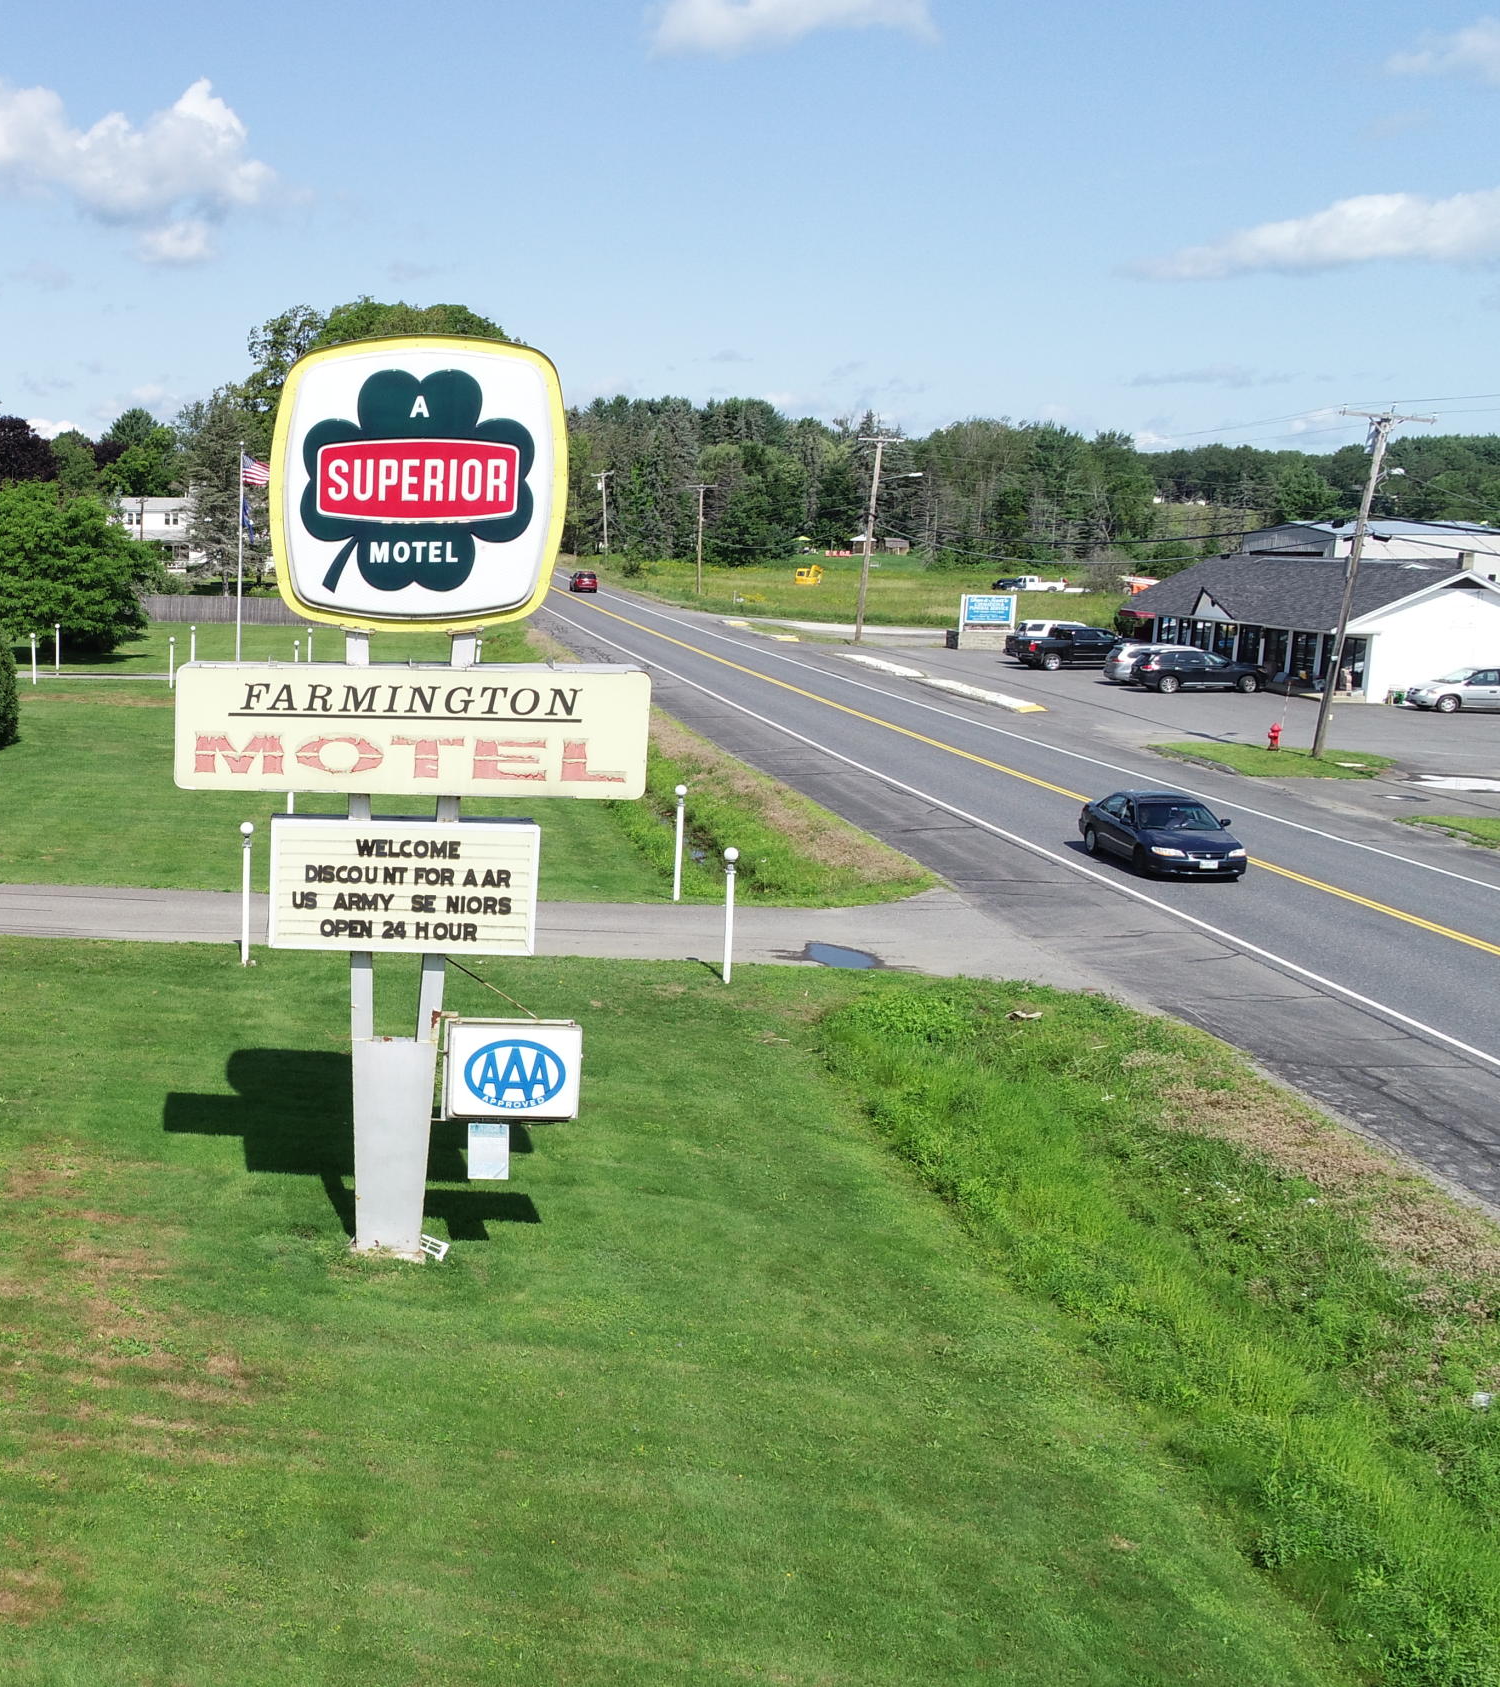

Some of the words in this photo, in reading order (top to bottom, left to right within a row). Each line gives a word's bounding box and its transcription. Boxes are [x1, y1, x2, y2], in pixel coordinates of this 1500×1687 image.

[409, 395, 430, 418] A
[327, 458, 508, 502] SUPERIOR
[369, 541, 459, 564] MOTEL
[239, 683, 584, 717] FARMINGTON
[193, 730, 628, 784] MOTEL
[356, 838, 461, 860] WELCOME
[305, 864, 409, 885] DISCOUNT
[414, 867, 455, 886] FOR
[292, 891, 318, 910] US
[333, 892, 395, 912] ARMY
[320, 918, 373, 939] OPEN
[381, 920, 407, 940] 24
[415, 921, 478, 942] HOUR
[478, 1047, 551, 1102] AAA
[482, 1095, 545, 1109] APPROVED
